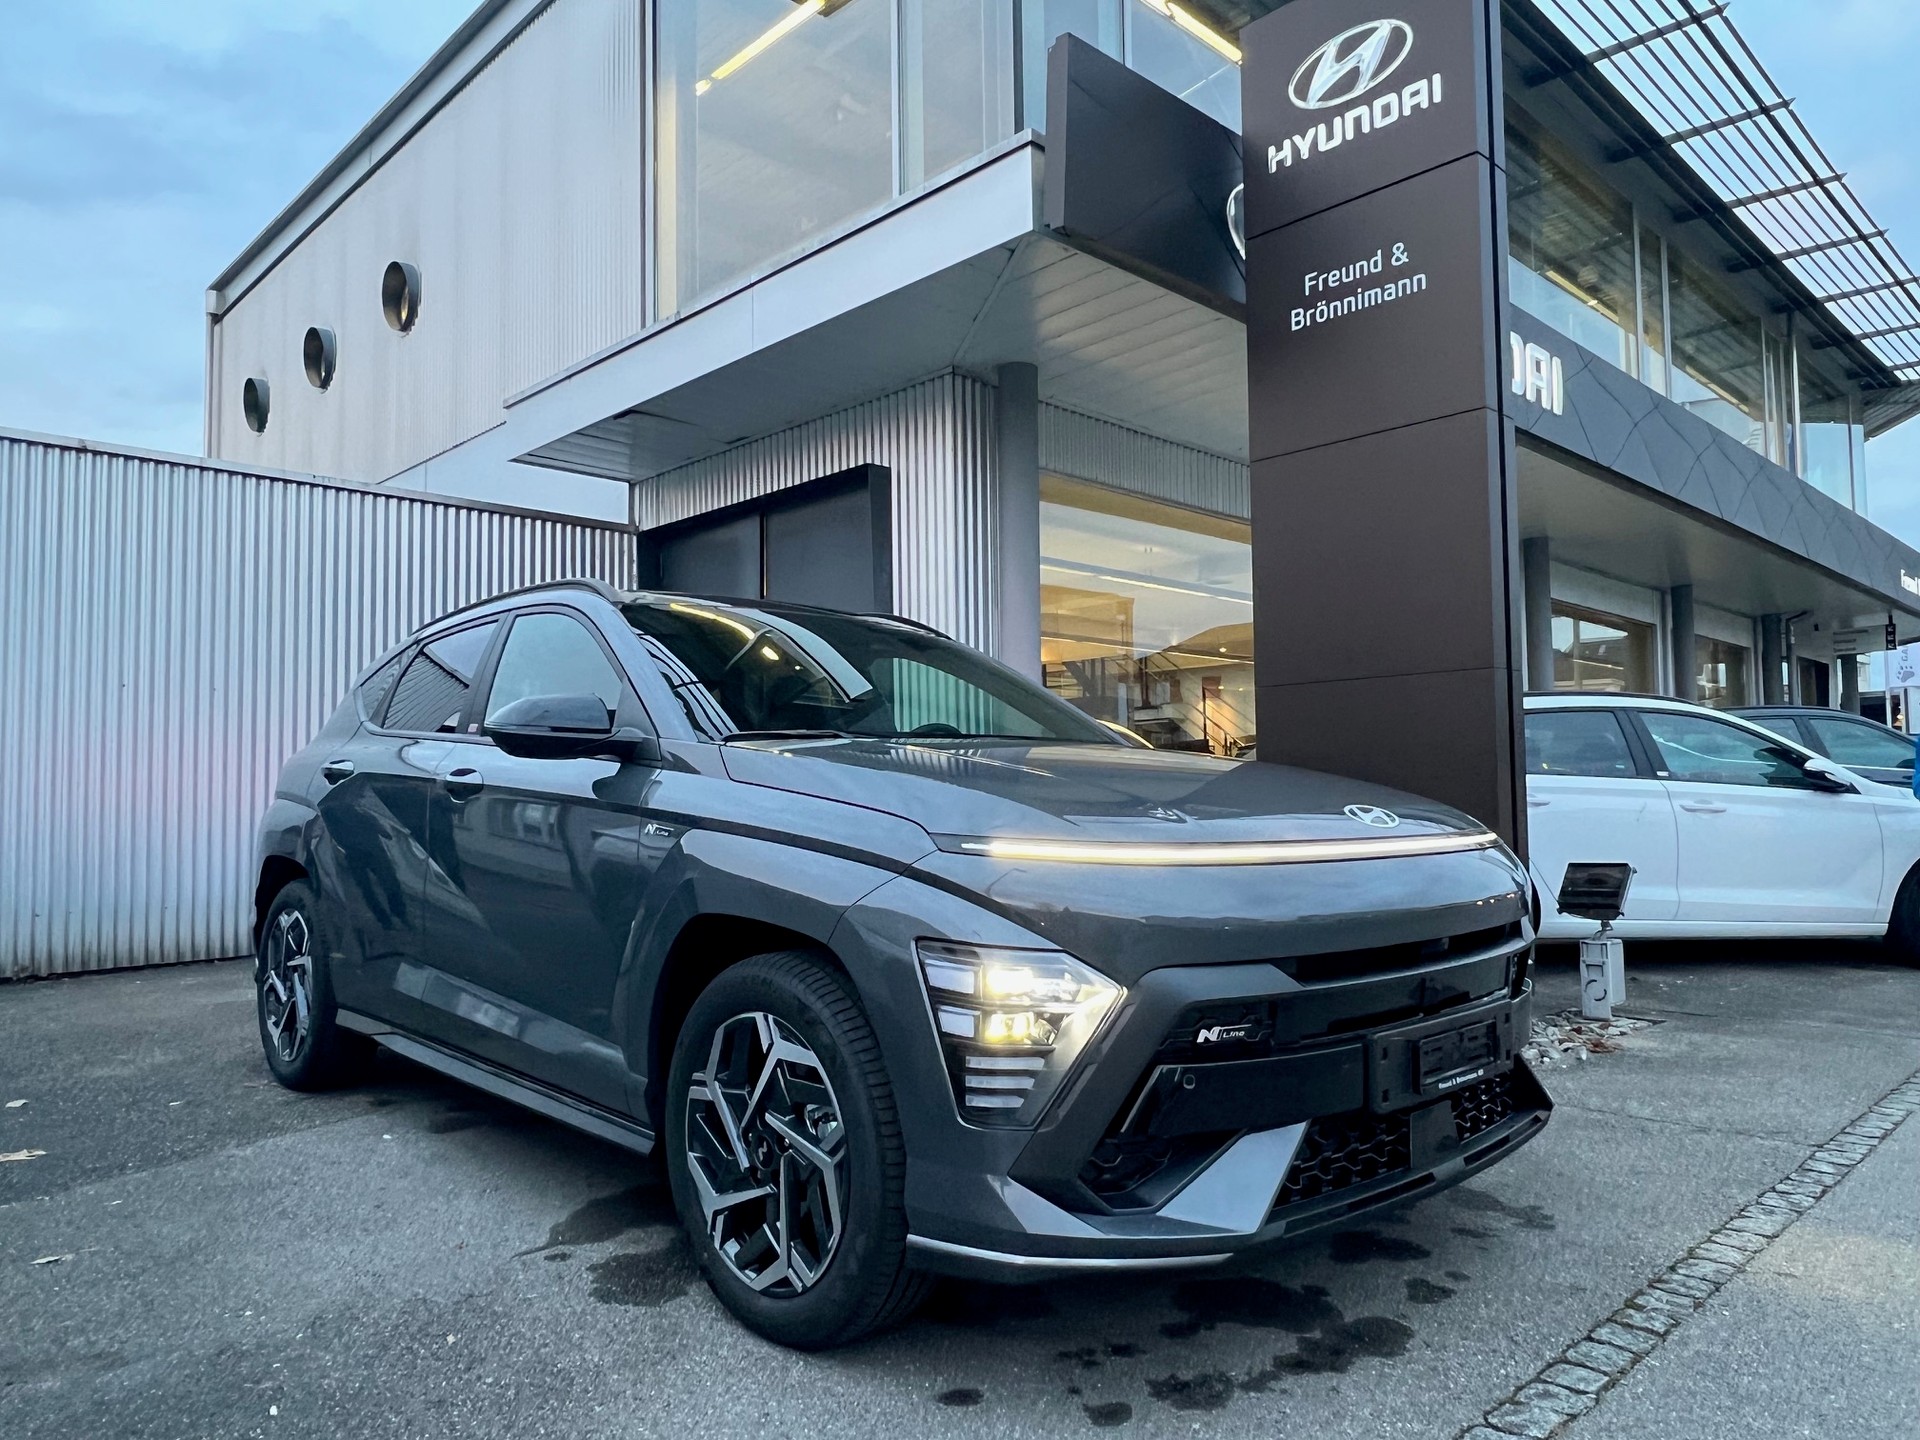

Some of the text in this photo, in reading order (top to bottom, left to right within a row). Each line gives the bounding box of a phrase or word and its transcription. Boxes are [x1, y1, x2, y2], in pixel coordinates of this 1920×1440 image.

[1267, 72, 1442, 174] HYUNDAI
[1304, 242, 1409, 296] Freund &
[1290, 273, 1427, 332] Brönnimann
